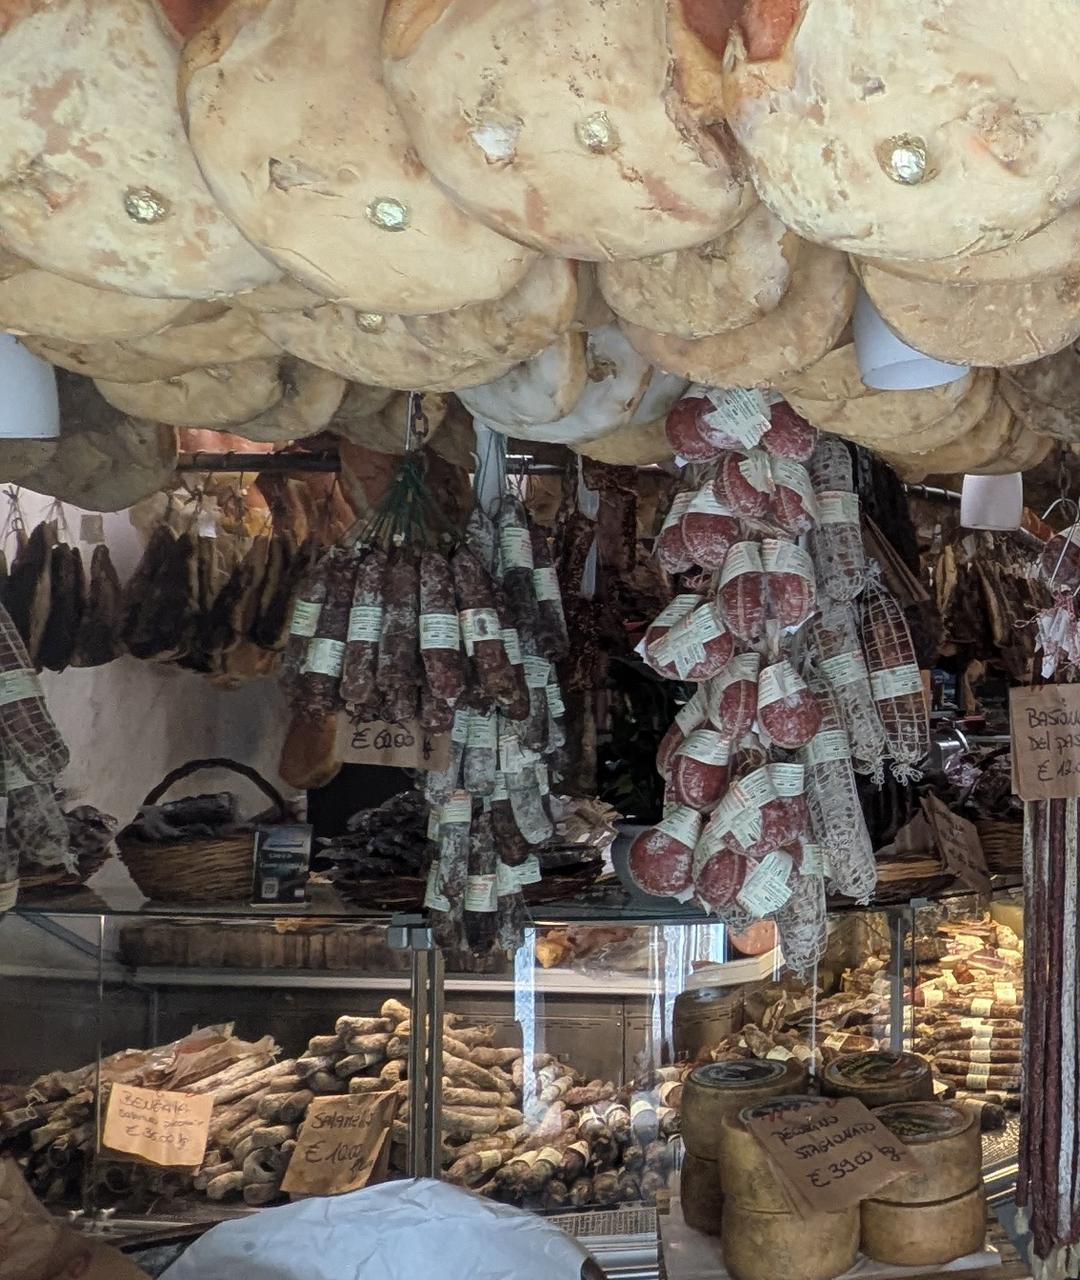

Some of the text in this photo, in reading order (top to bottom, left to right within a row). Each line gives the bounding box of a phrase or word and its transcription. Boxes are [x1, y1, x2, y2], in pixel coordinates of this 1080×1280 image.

[1037, 758, 1054, 782] €
[304, 1140, 327, 1164] €
[805, 1168, 831, 1188] €
